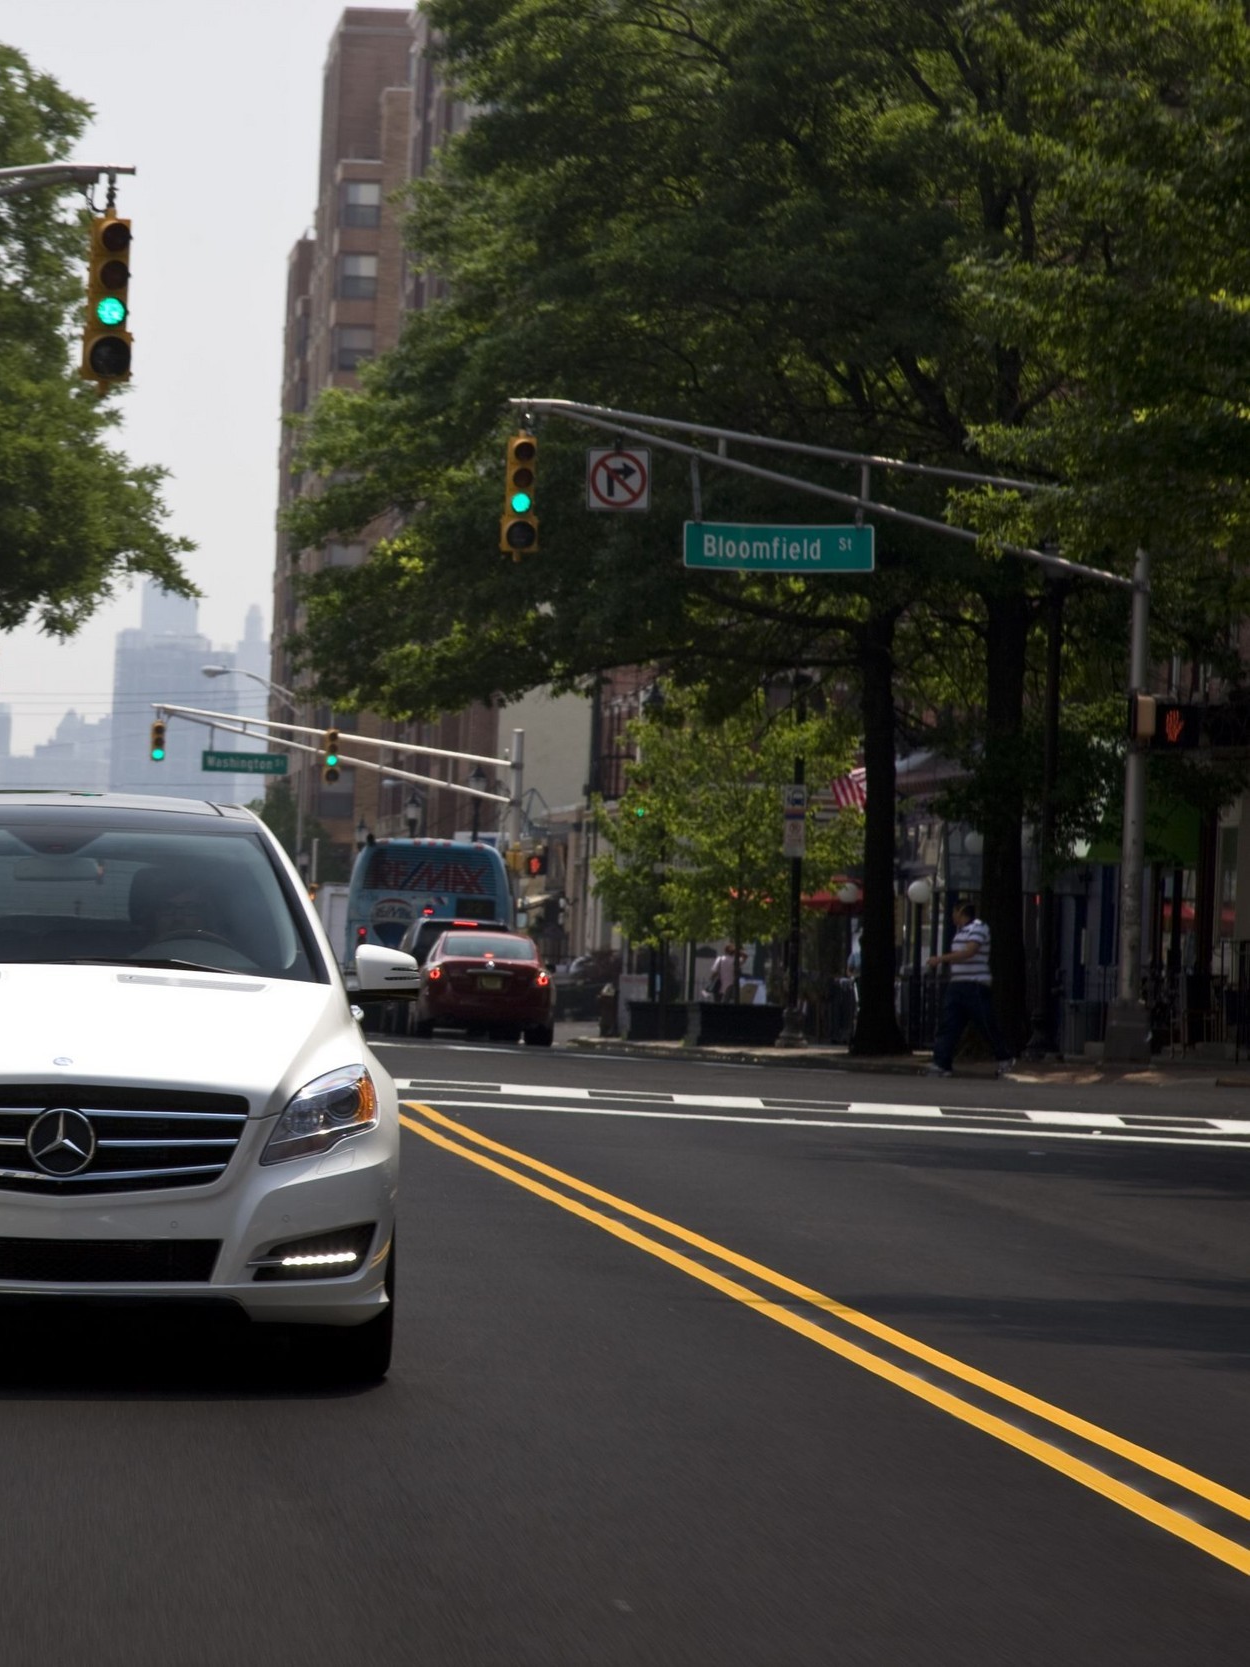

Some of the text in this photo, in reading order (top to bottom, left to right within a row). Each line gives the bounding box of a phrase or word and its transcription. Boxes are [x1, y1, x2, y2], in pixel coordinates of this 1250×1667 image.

[703, 534, 852, 560] Bloomfield St
[206, 756, 273, 770] Washington
[371, 861, 488, 893] RE/MAX
